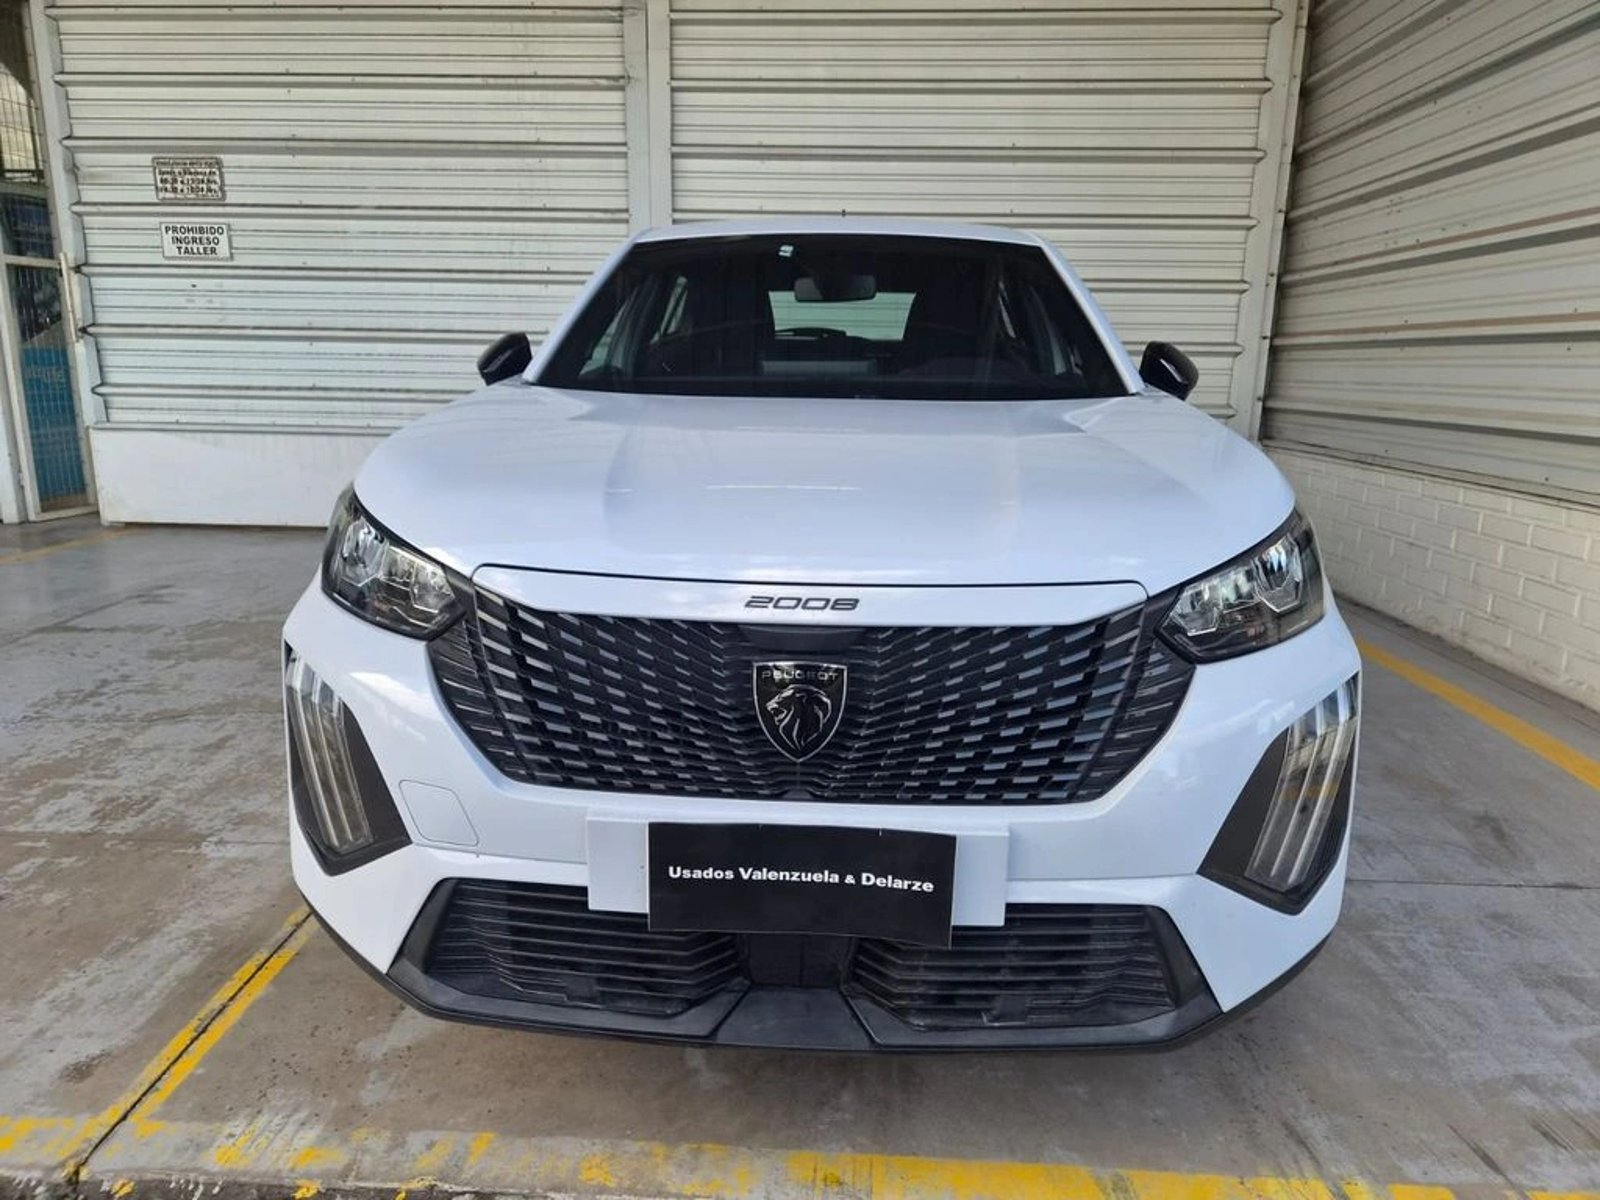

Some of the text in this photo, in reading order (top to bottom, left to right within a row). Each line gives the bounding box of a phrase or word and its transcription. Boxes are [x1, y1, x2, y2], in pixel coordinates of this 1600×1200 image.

[164, 225, 224, 235] PROHIBIDO
[171, 235, 220, 245] INGRESO
[176, 246, 218, 255] TALLER
[744, 595, 860, 611] 2008
[667, 866, 934, 892] Usados Valenzuela & Delarze
